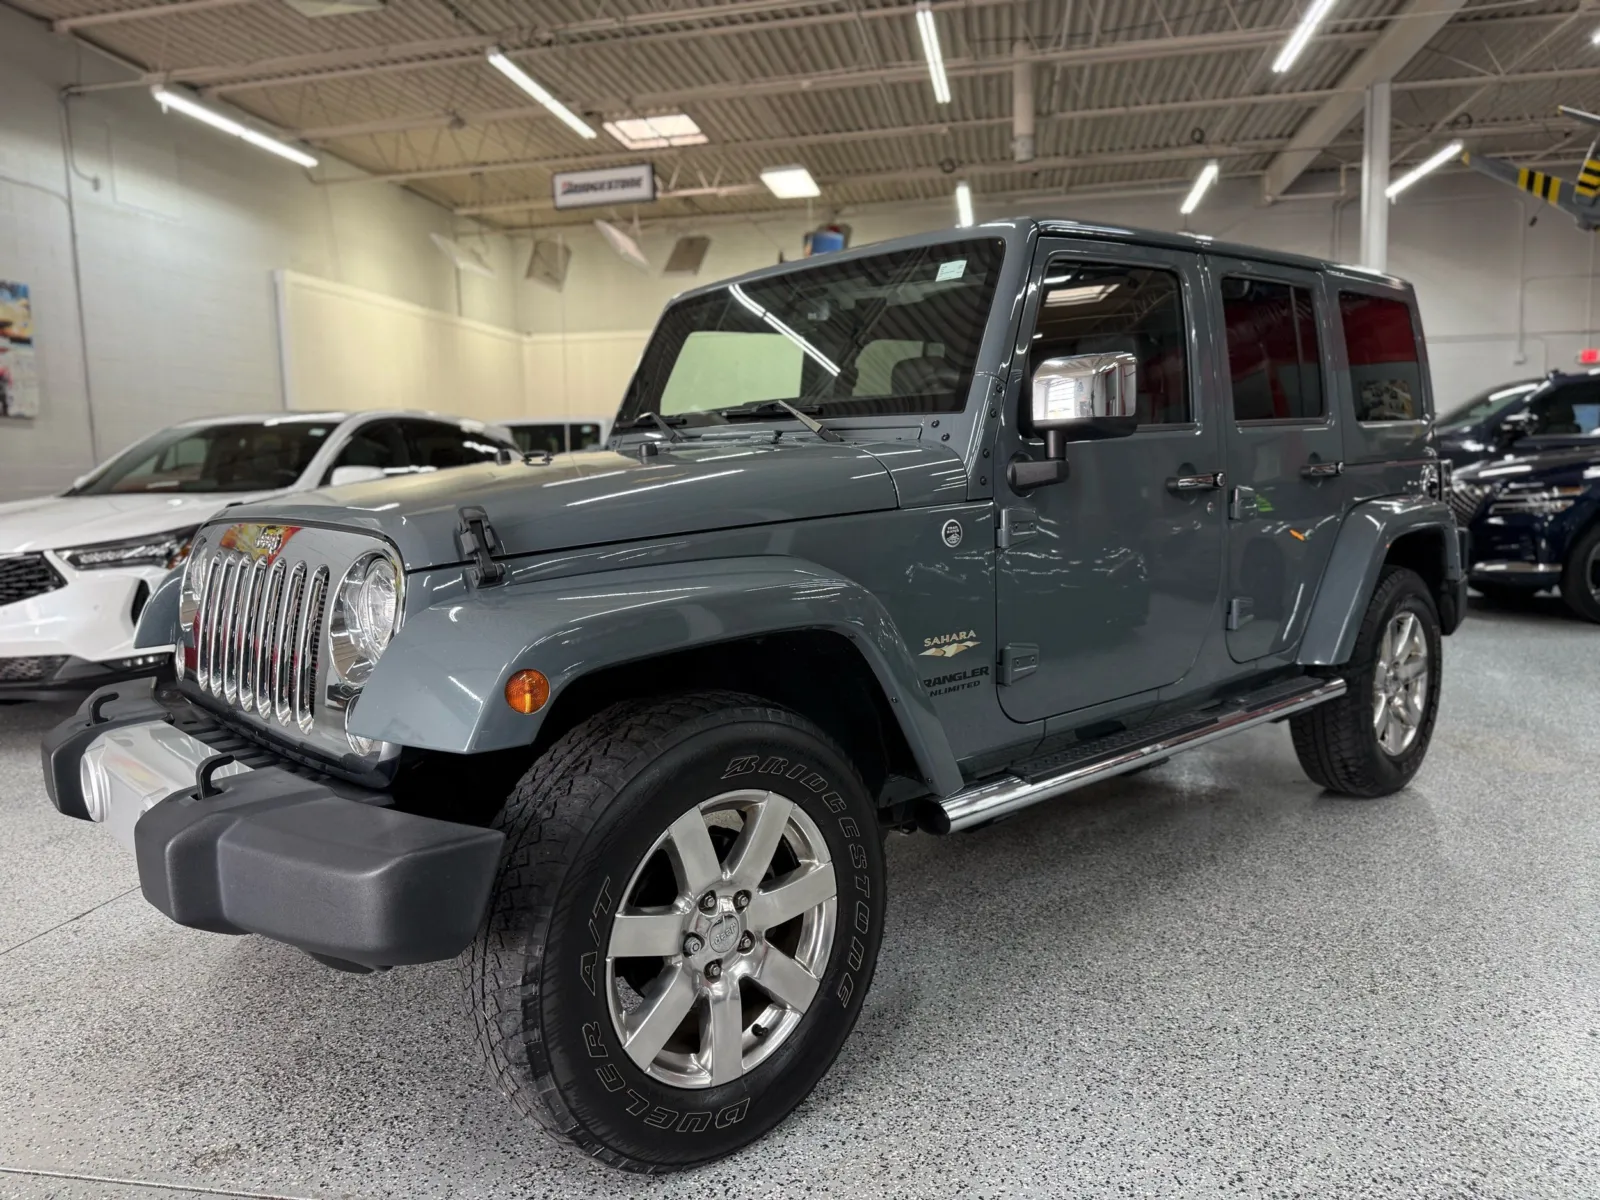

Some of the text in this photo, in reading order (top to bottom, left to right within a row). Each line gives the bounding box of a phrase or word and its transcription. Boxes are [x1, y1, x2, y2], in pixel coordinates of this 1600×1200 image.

[923, 629, 977, 647] SAHARA
[923, 666, 989, 688] RANGLER
[928, 680, 981, 697] NLIMITED
[721, 756, 870, 1008] BRIDGESTONE
[580, 876, 750, 1132] DUELER A/T
